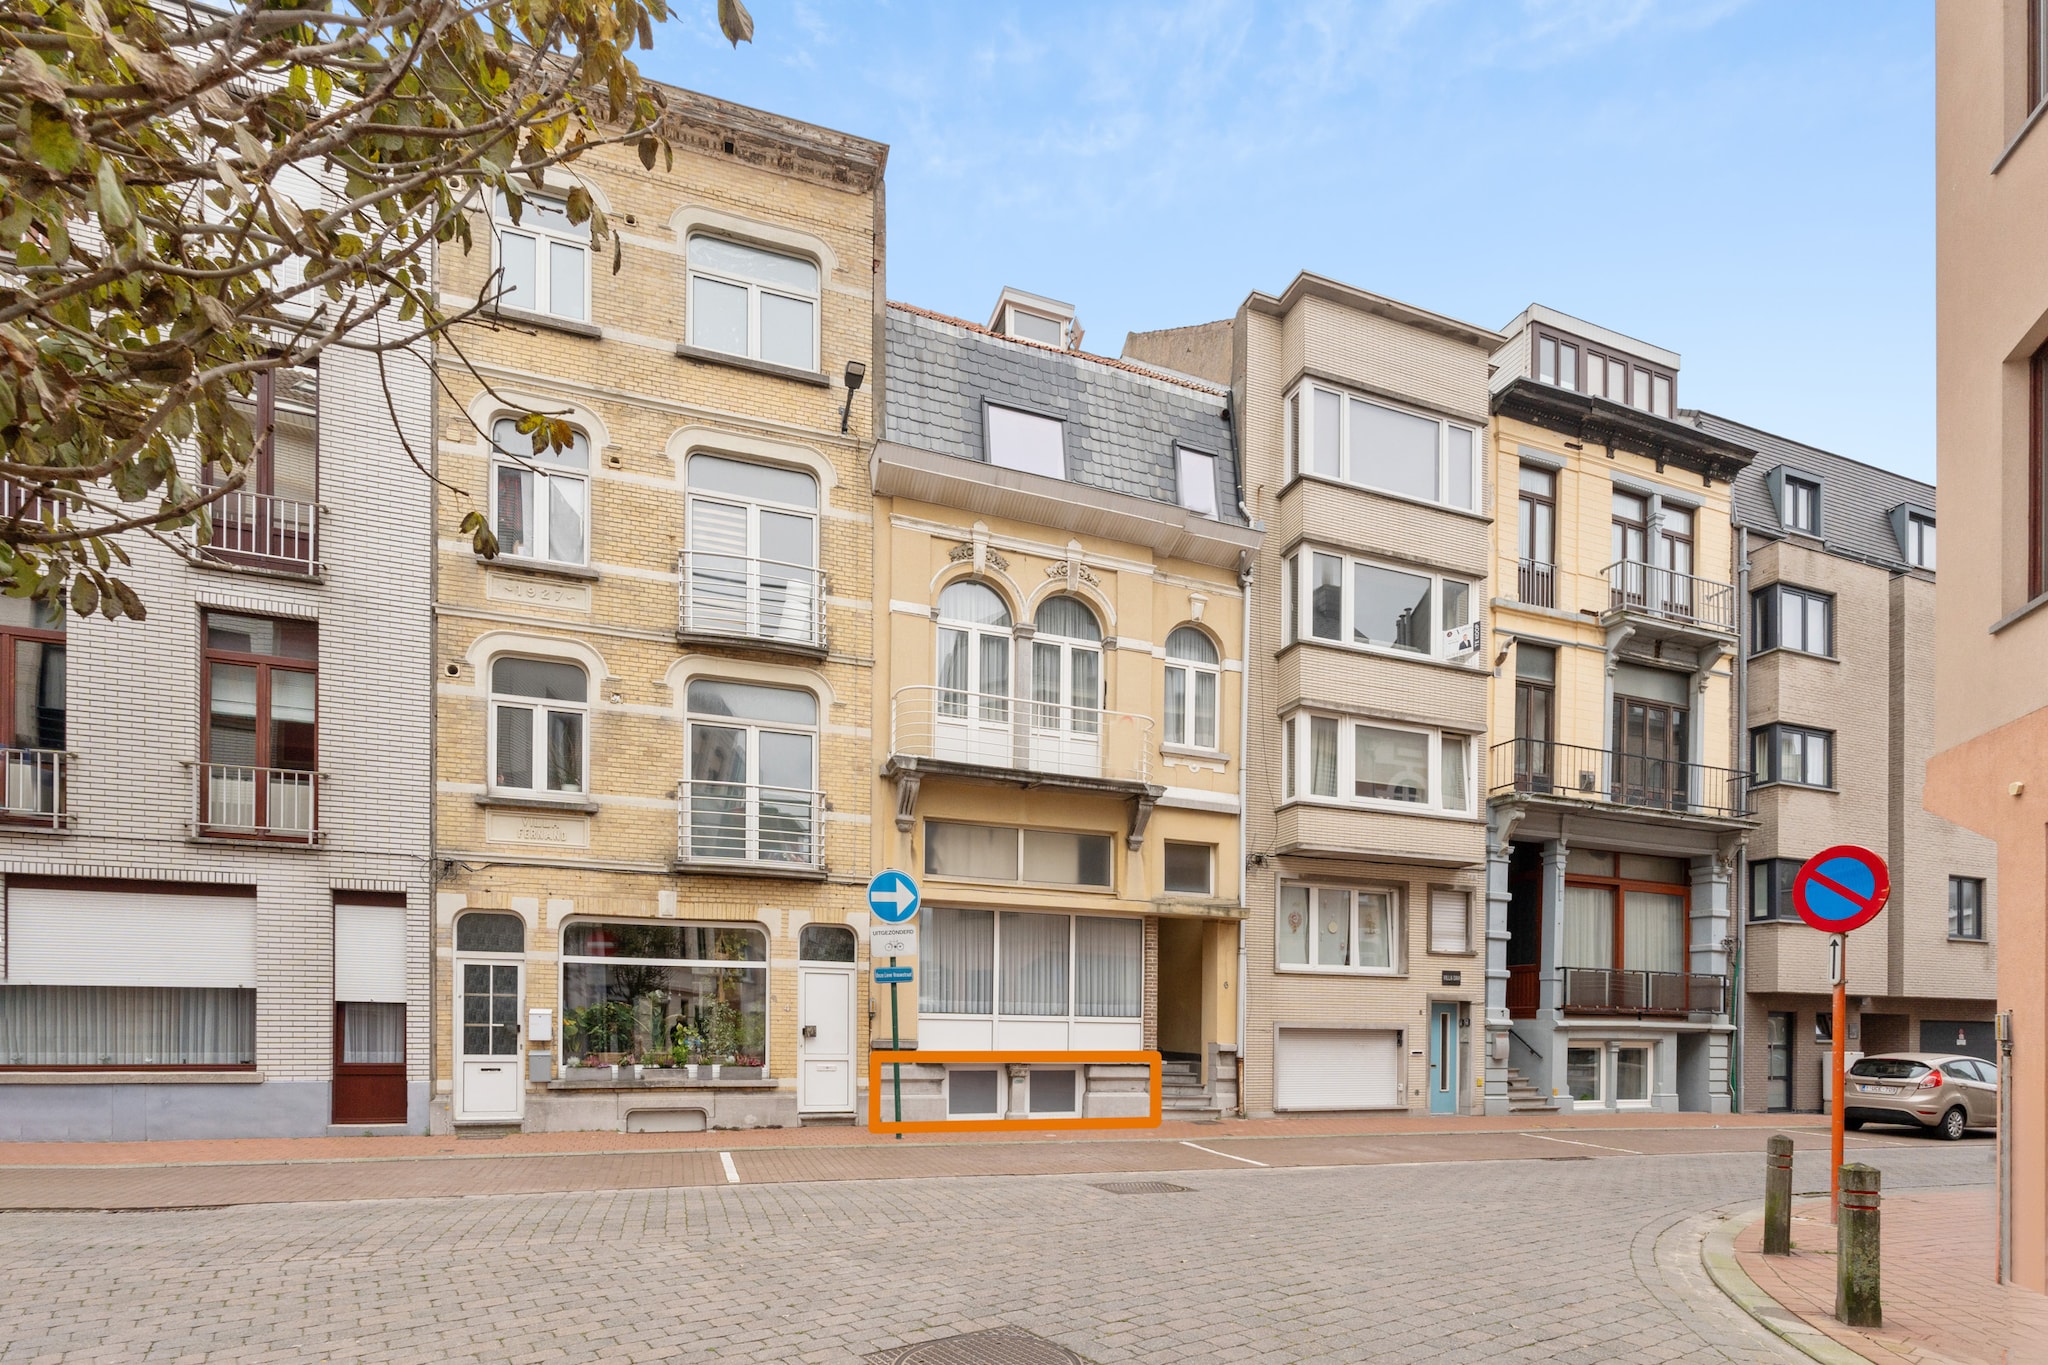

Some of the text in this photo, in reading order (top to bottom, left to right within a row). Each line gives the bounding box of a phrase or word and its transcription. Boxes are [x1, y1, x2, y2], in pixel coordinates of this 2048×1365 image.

[516, 585, 563, 602] 1927
[521, 817, 560, 829] VILLA
[518, 829, 567, 842] FERNAND
